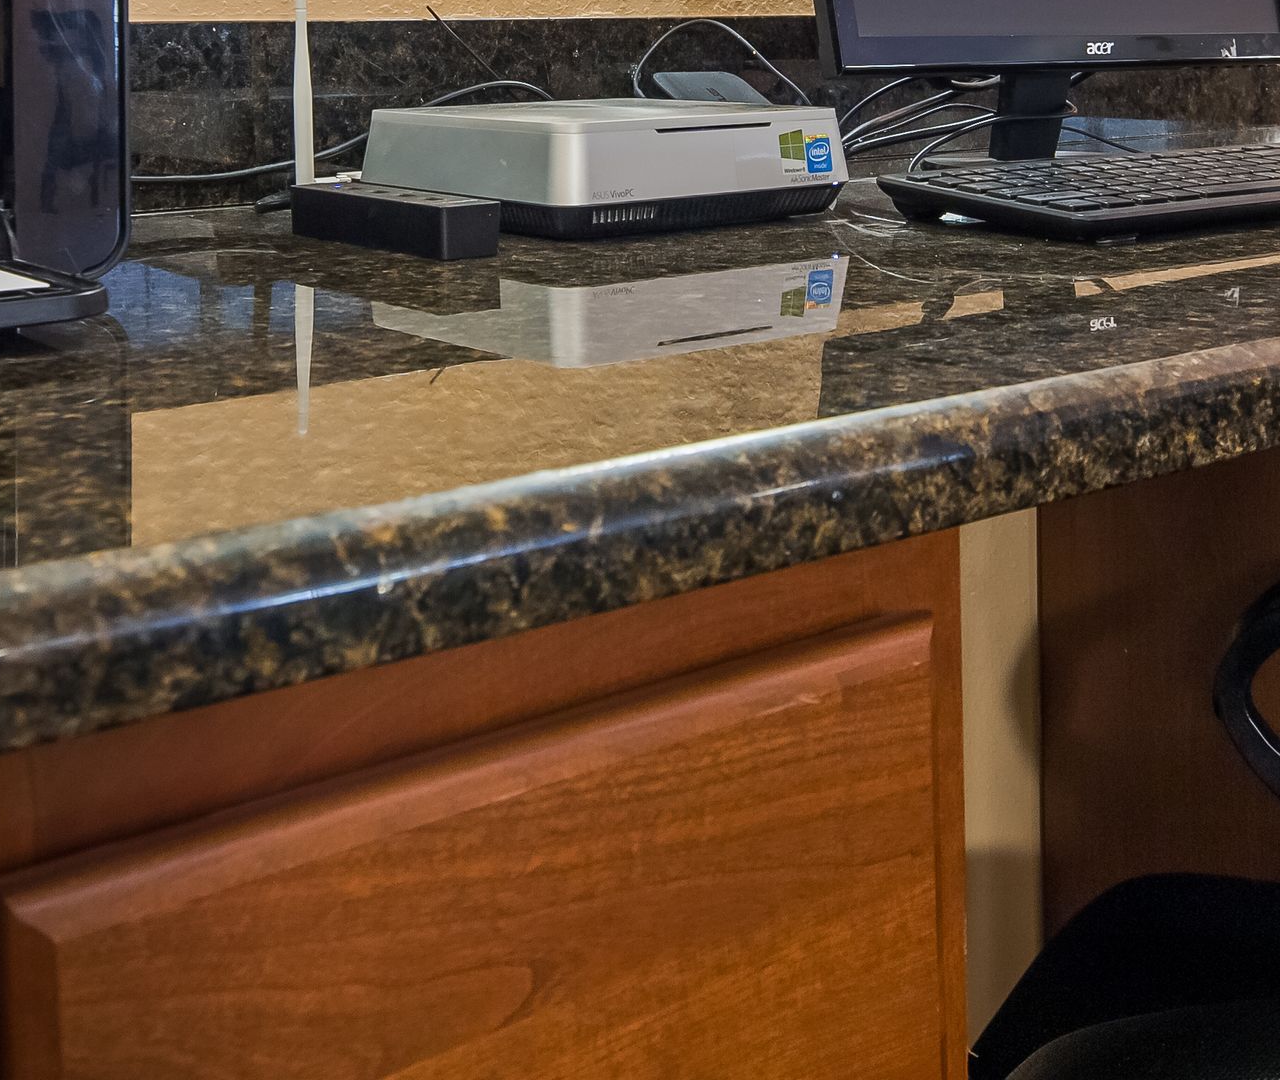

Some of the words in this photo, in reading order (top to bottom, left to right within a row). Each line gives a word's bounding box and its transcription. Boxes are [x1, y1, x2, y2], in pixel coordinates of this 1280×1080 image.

[1086, 41, 1115, 55] acer
[592, 191, 610, 200] ASUS
[609, 188, 635, 199] VivoPC
